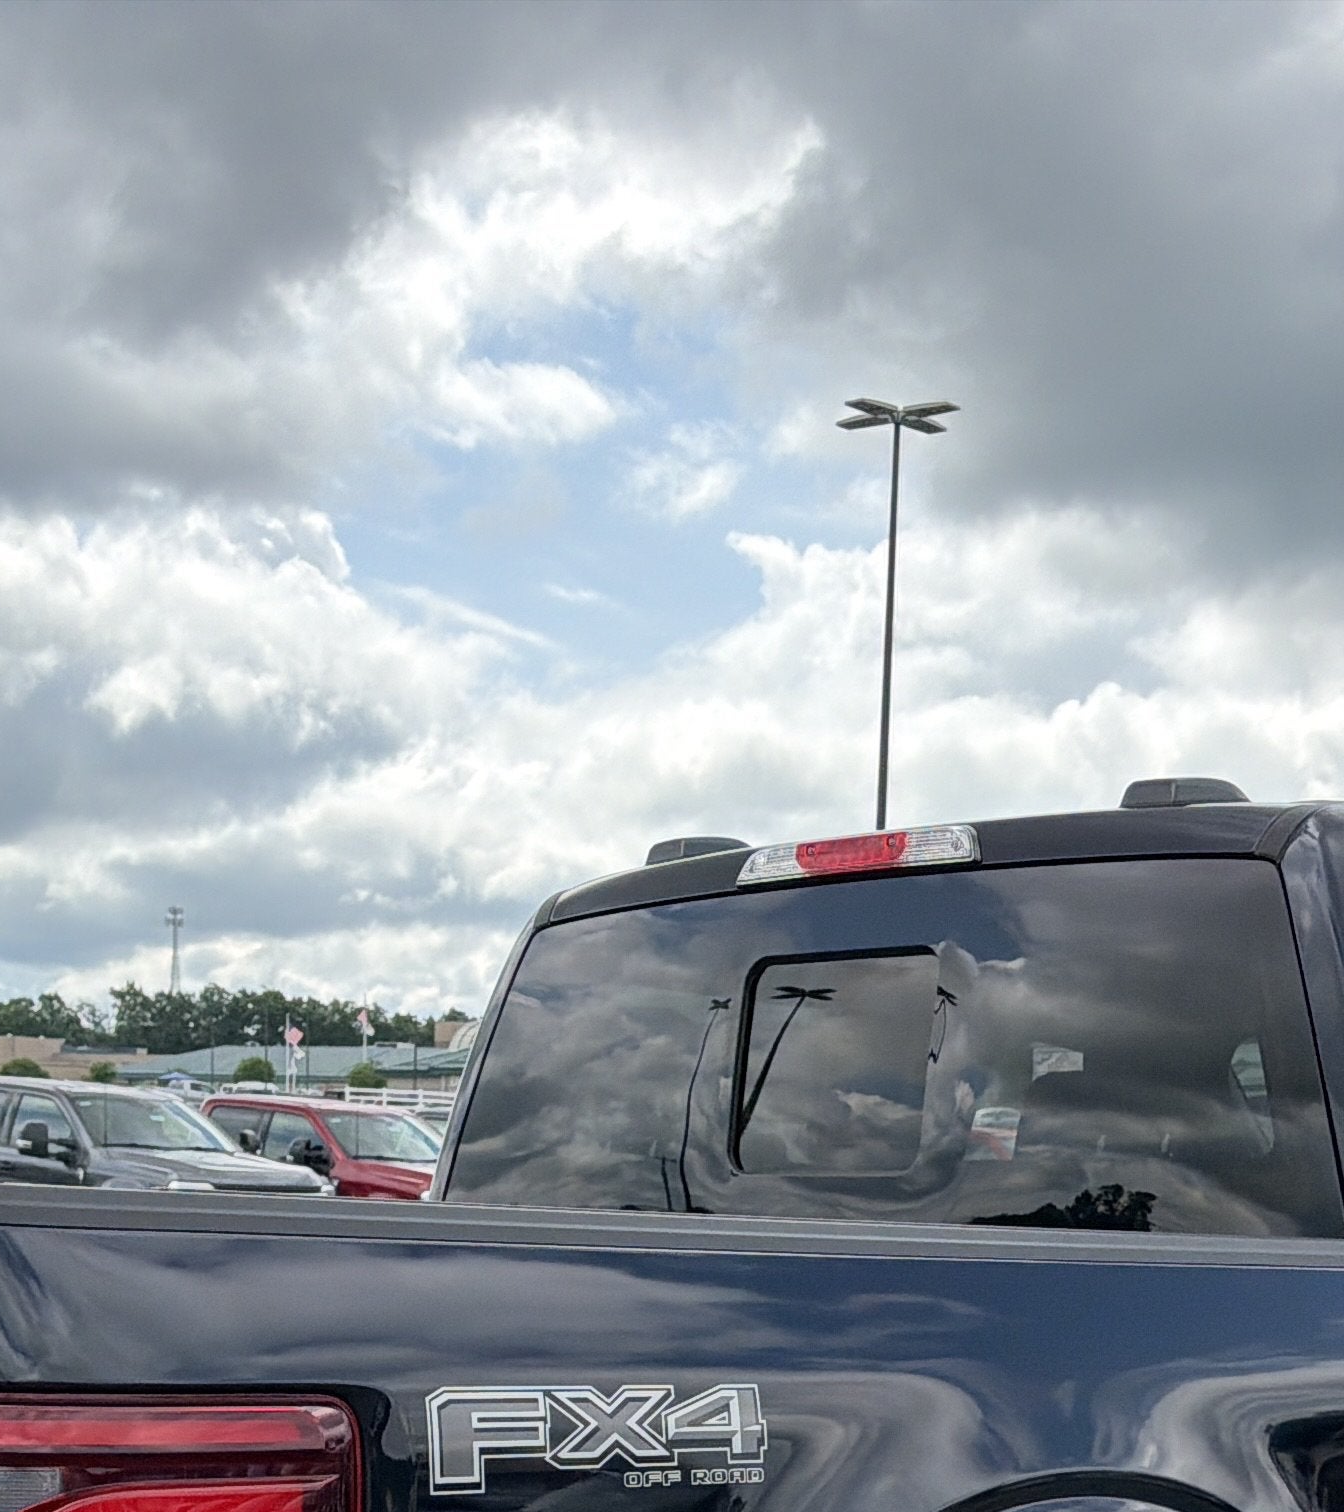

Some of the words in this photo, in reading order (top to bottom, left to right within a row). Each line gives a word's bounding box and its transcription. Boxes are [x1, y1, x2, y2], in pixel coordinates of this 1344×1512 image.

[425, 1384, 768, 1496] FX4
[623, 1470, 682, 1488] OFF
[691, 1468, 765, 1486] ROAD
